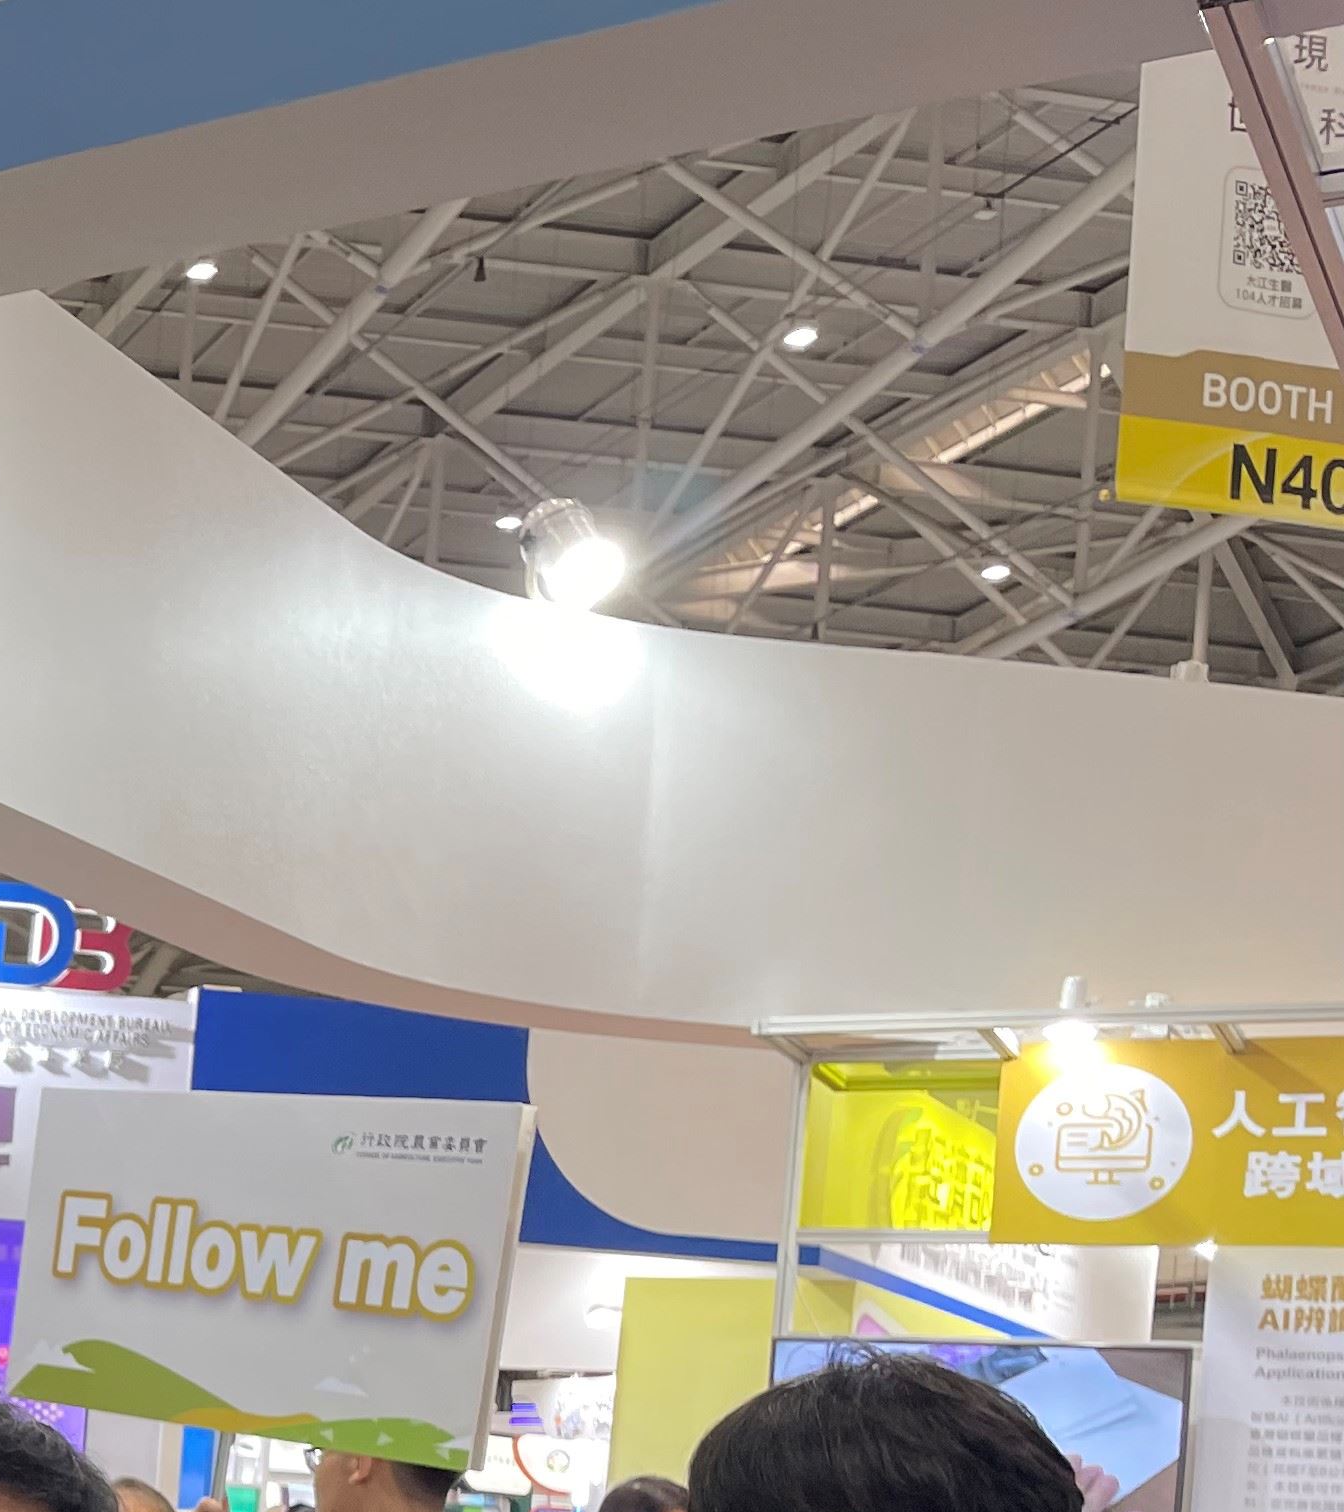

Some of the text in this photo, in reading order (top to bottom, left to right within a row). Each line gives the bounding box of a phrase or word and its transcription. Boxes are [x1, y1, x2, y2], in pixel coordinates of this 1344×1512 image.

[1202, 372, 1333, 425] BOOTH
[54, 1191, 474, 1321] Follow me
